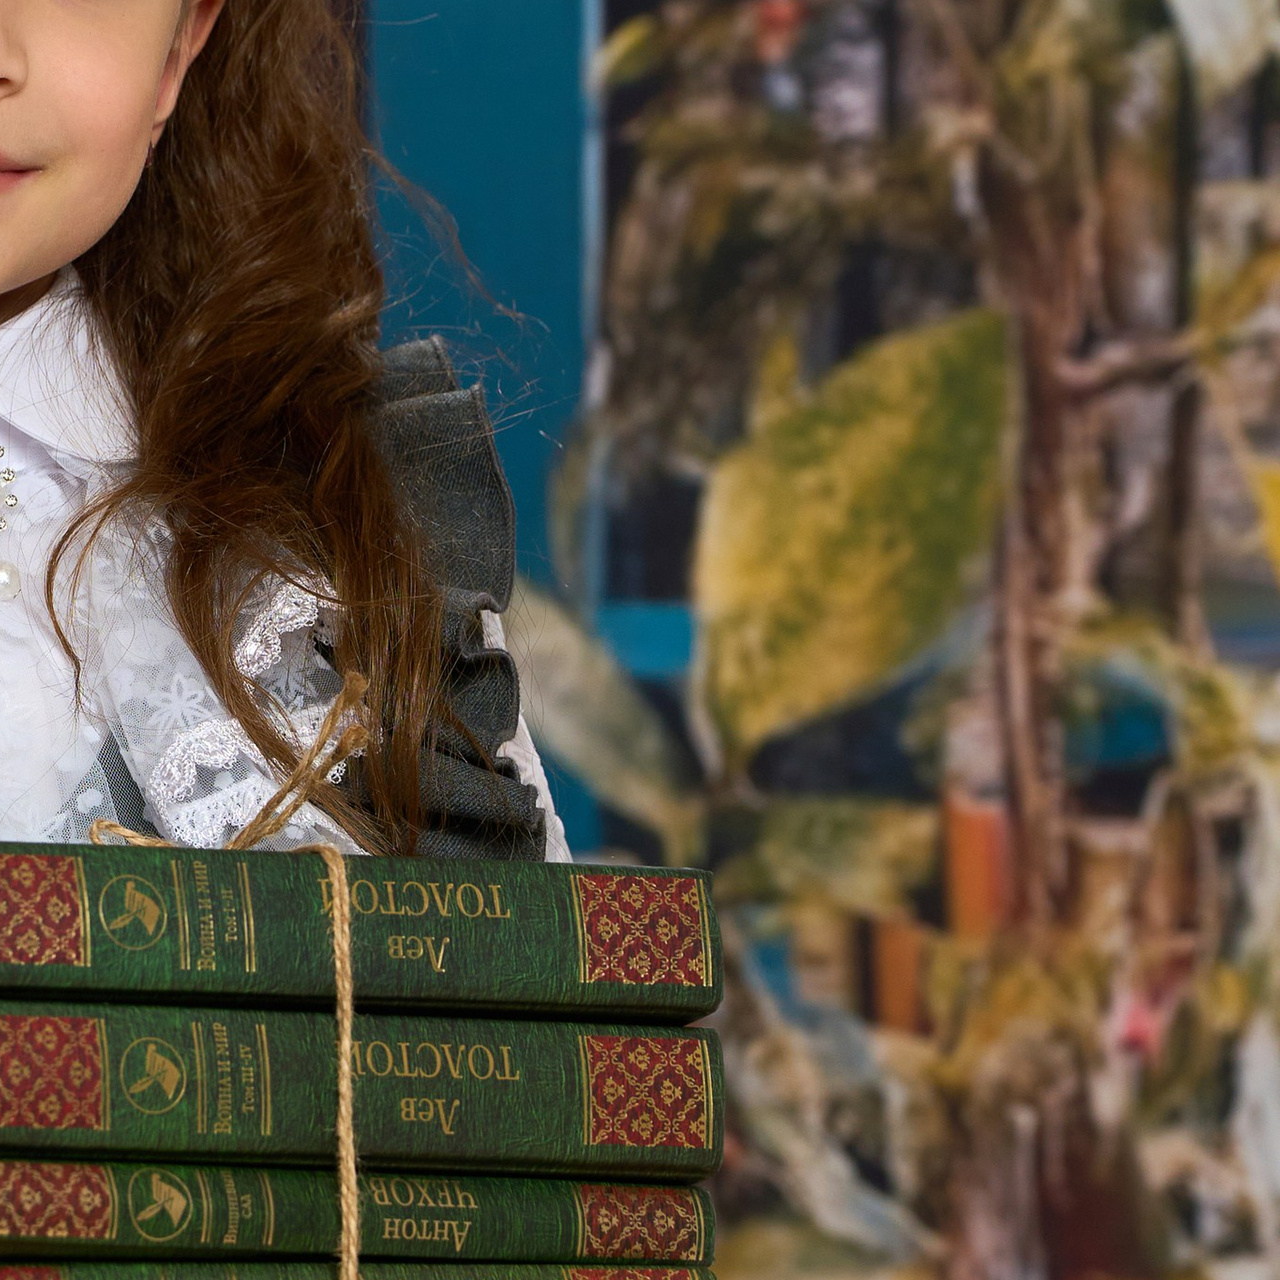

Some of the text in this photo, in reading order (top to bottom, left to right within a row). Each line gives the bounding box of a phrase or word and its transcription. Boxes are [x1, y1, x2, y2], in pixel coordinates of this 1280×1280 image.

[387, 935, 451, 973] Лев
[400, 1097, 460, 1135] Лев
[370, 1177, 478, 1209] ЧЕХОВ
[382, 1218, 472, 1253] Антон
